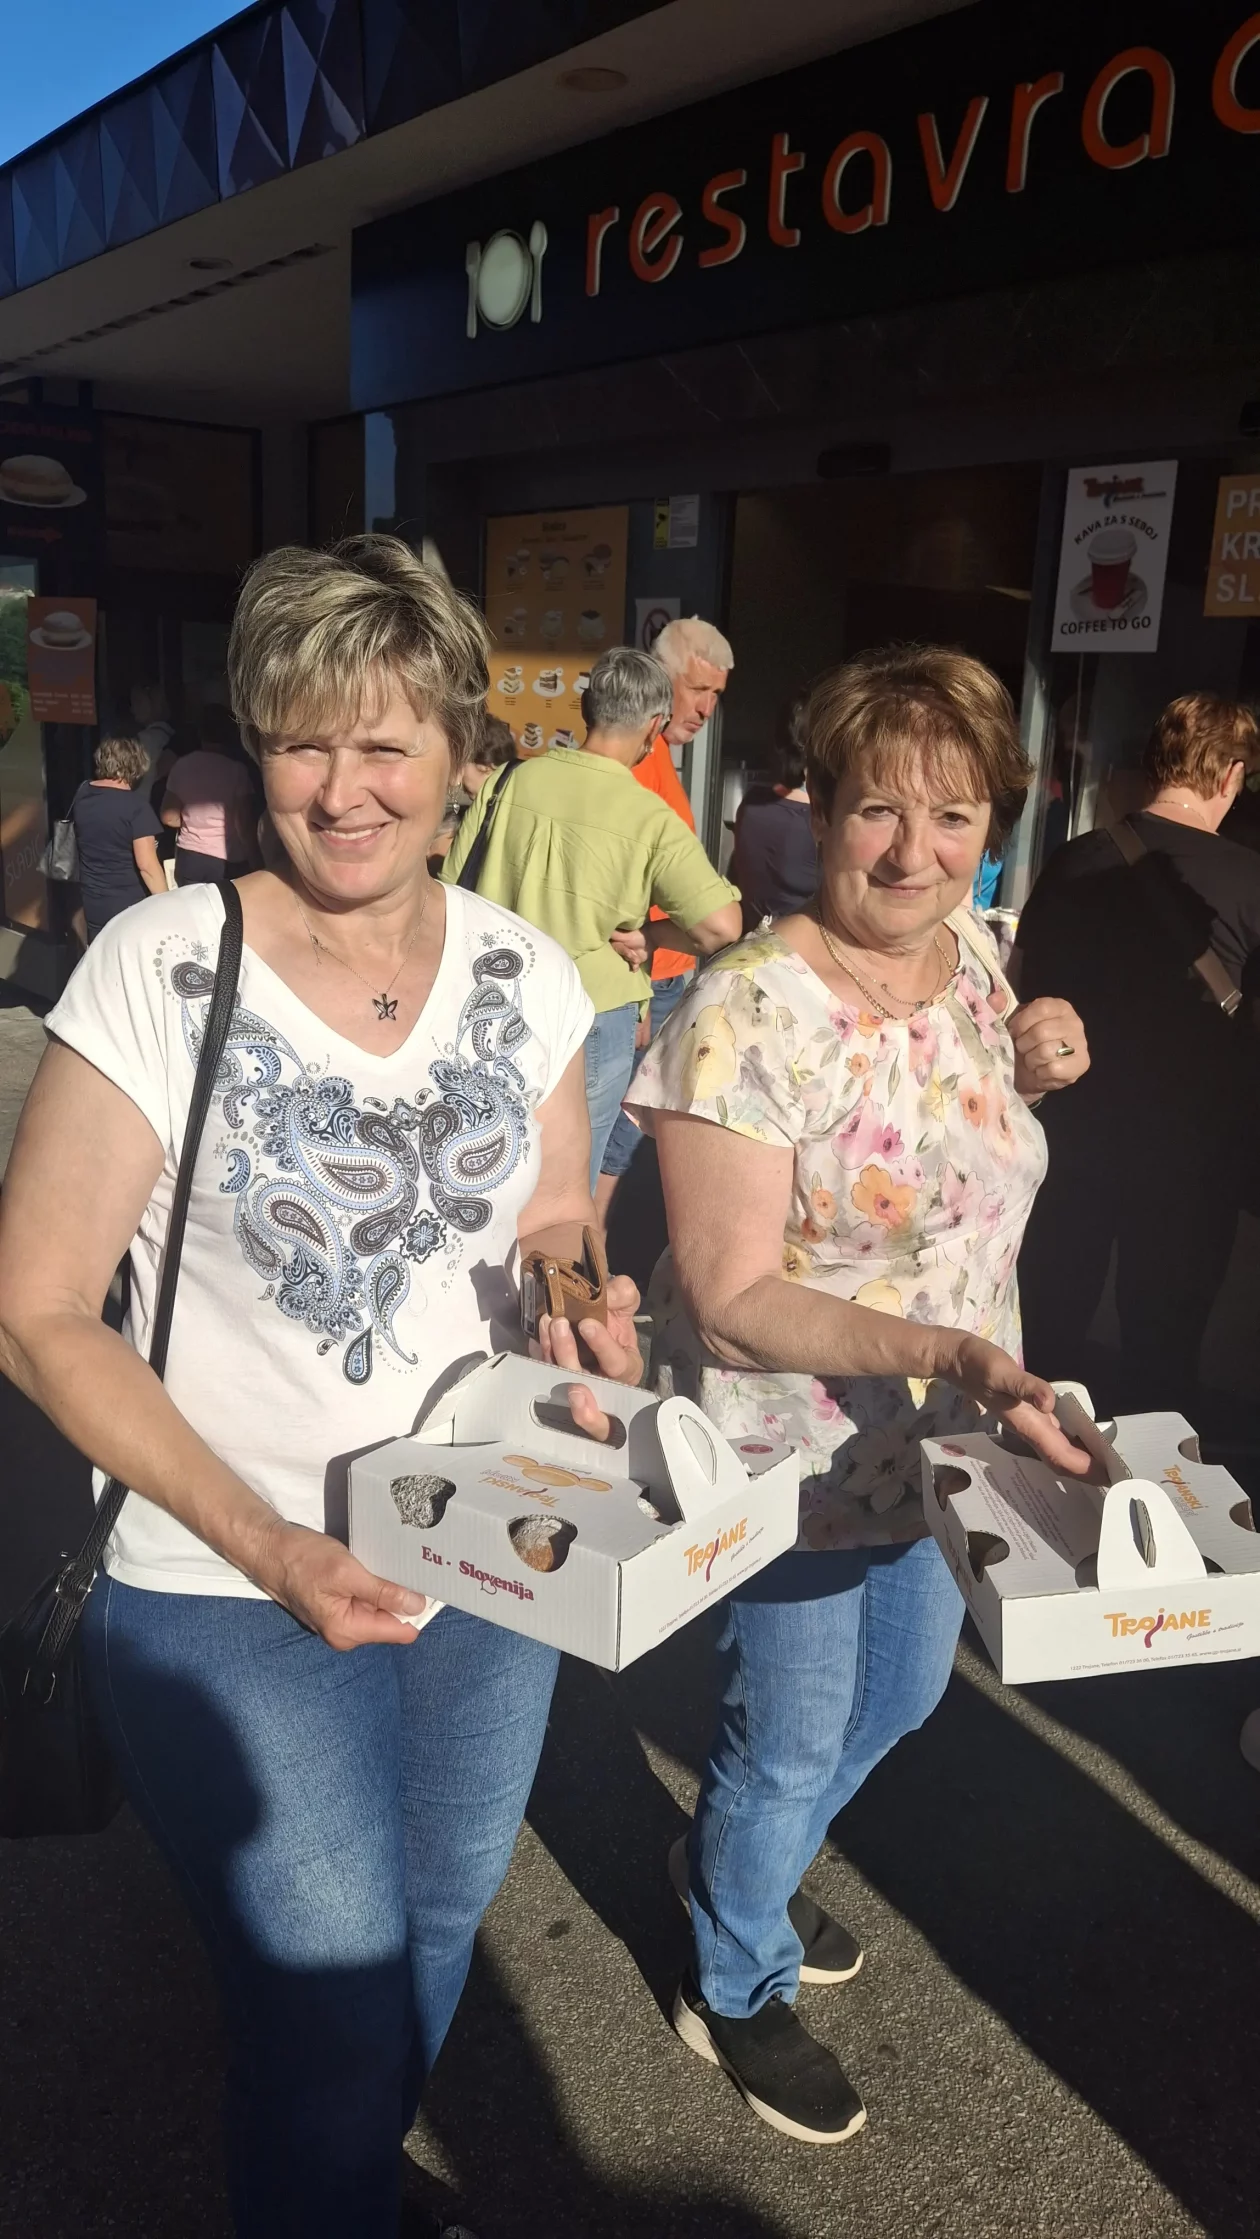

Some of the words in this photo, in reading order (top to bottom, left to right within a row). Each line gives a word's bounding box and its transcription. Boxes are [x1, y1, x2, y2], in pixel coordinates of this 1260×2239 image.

[1074, 522, 1101, 545] KAVA
[1104, 515, 1117, 526] ZA
[1120, 515, 1127, 525] S
[1129, 516, 1159, 540] SEBOJ
[1216, 573, 1260, 603] SL
[1060, 619, 1108, 635] COFFEE
[1111, 618, 1127, 631] TO
[1131, 616, 1151, 629] GO
[421, 1545, 443, 1565] Eu
[459, 1560, 534, 1600] Slovenija
